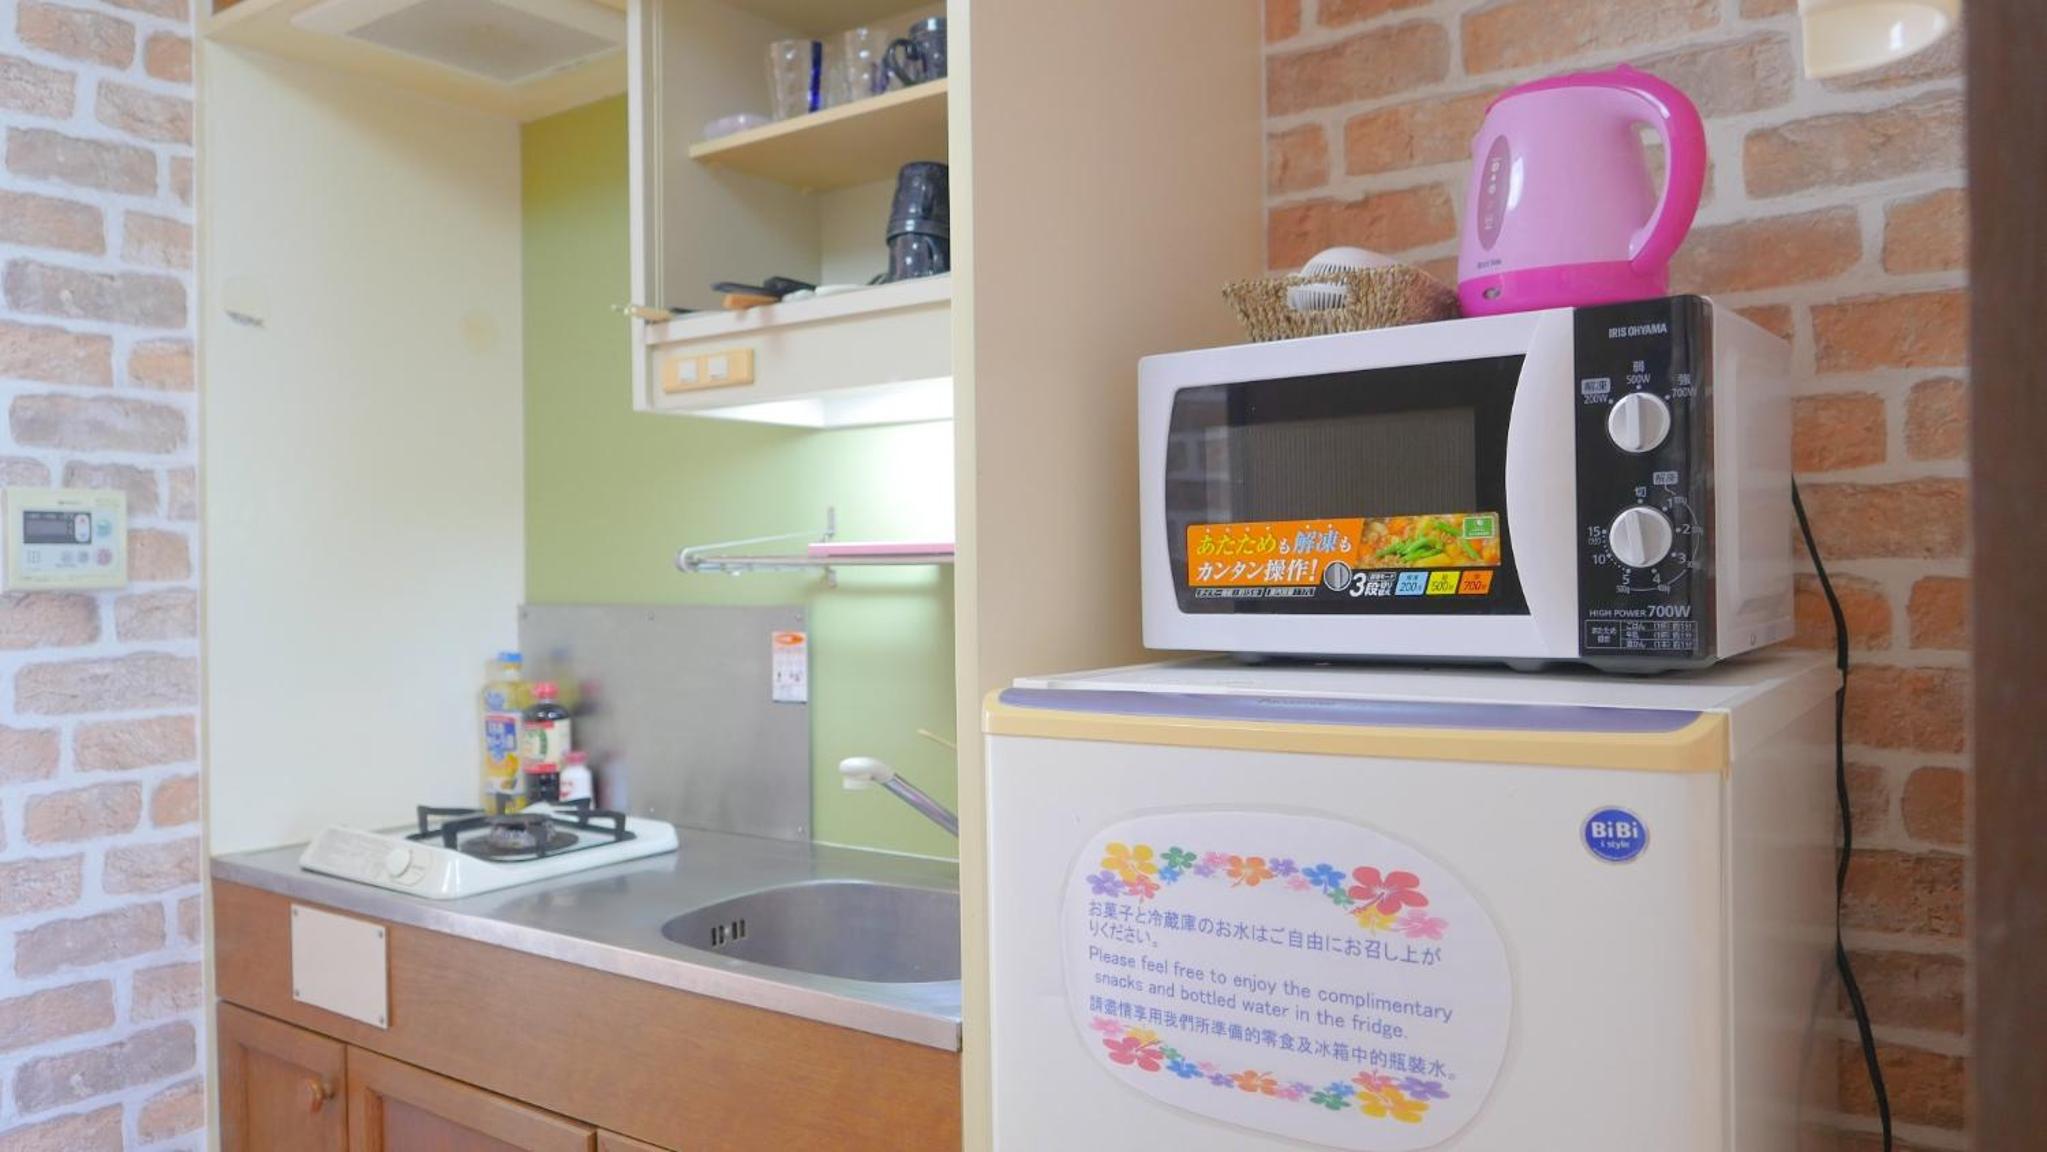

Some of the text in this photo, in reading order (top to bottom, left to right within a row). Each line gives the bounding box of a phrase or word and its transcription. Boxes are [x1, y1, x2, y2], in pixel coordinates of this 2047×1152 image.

[1608, 323, 1668, 338] IRIS OHYAMA
[1626, 373, 1651, 385] 500W
[1671, 387, 1697, 399] 700W
[1667, 498, 1674, 509] 1
[1587, 526, 1601, 537] 15
[1681, 523, 1691, 535] 2
[1197, 530, 1351, 556] あたためも解凍も
[1592, 553, 1606, 565] 10
[1678, 552, 1687, 565] 3
[1197, 558, 1319, 582] カンタン操作!
[1622, 574, 1630, 585] 5
[1652, 572, 1661, 584] 4
[1589, 605, 1691, 618] HIGH POWER 700W
[1591, 821, 1639, 839] BiBi
[1089, 901, 1442, 966] お菓子と冷蔵庫のお水はご自由にお召し上が
[1089, 919, 1158, 948] りください。
[1089, 945, 1453, 1024] Please feel free to enjoy the complimentary
[1095, 972, 1408, 1040] snacks and bottled water in the fridge.
[1089, 995, 1456, 1080] 請盡情享用我們所準備的零食及冰箱中的瓶裝水。
